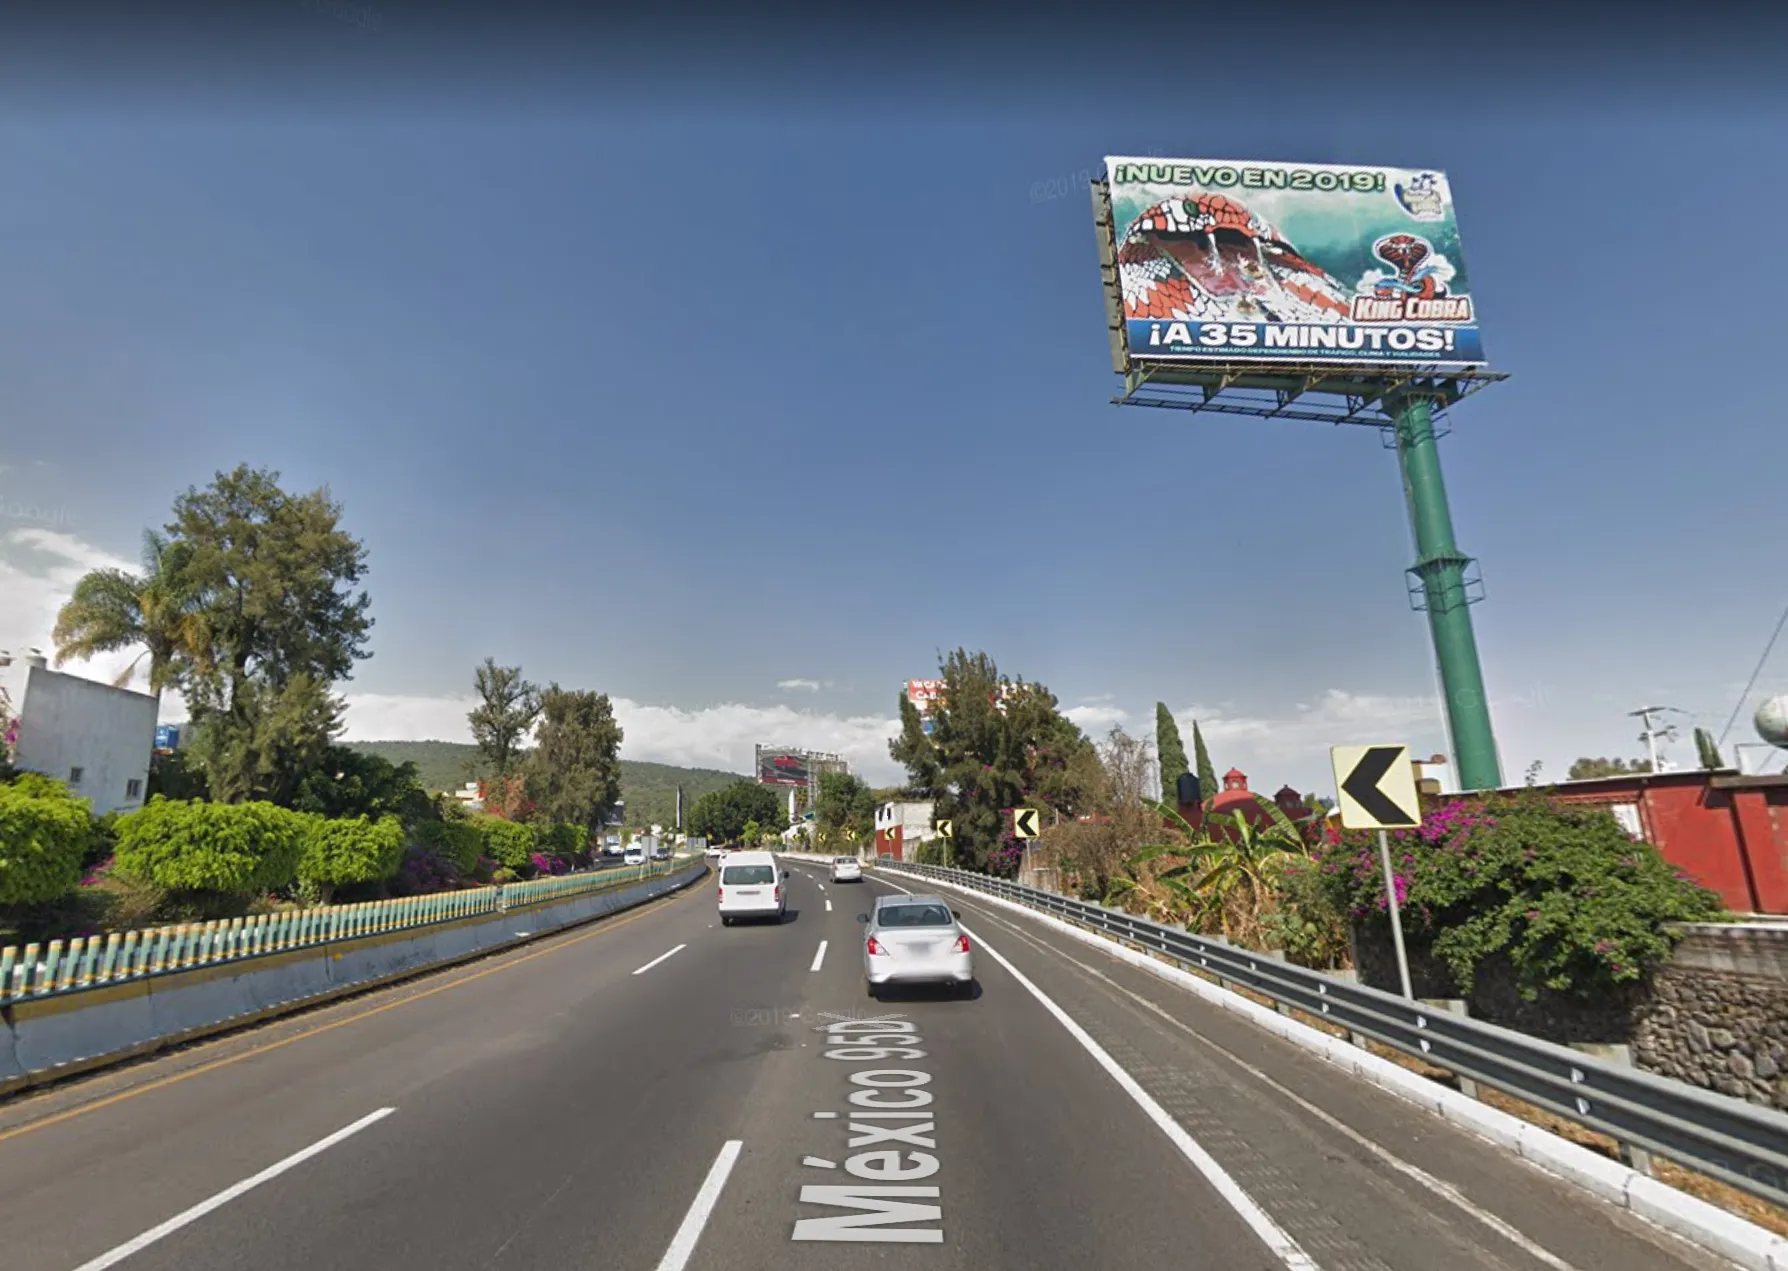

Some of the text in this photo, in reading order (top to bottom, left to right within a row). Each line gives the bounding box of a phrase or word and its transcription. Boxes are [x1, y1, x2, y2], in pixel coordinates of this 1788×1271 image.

[1115, 163, 1386, 192] ¡NUEVO EN 2019!
[1355, 297, 1470, 320] KING COBRA
[1149, 323, 1455, 351] ¡A 35 MINUTOS!
